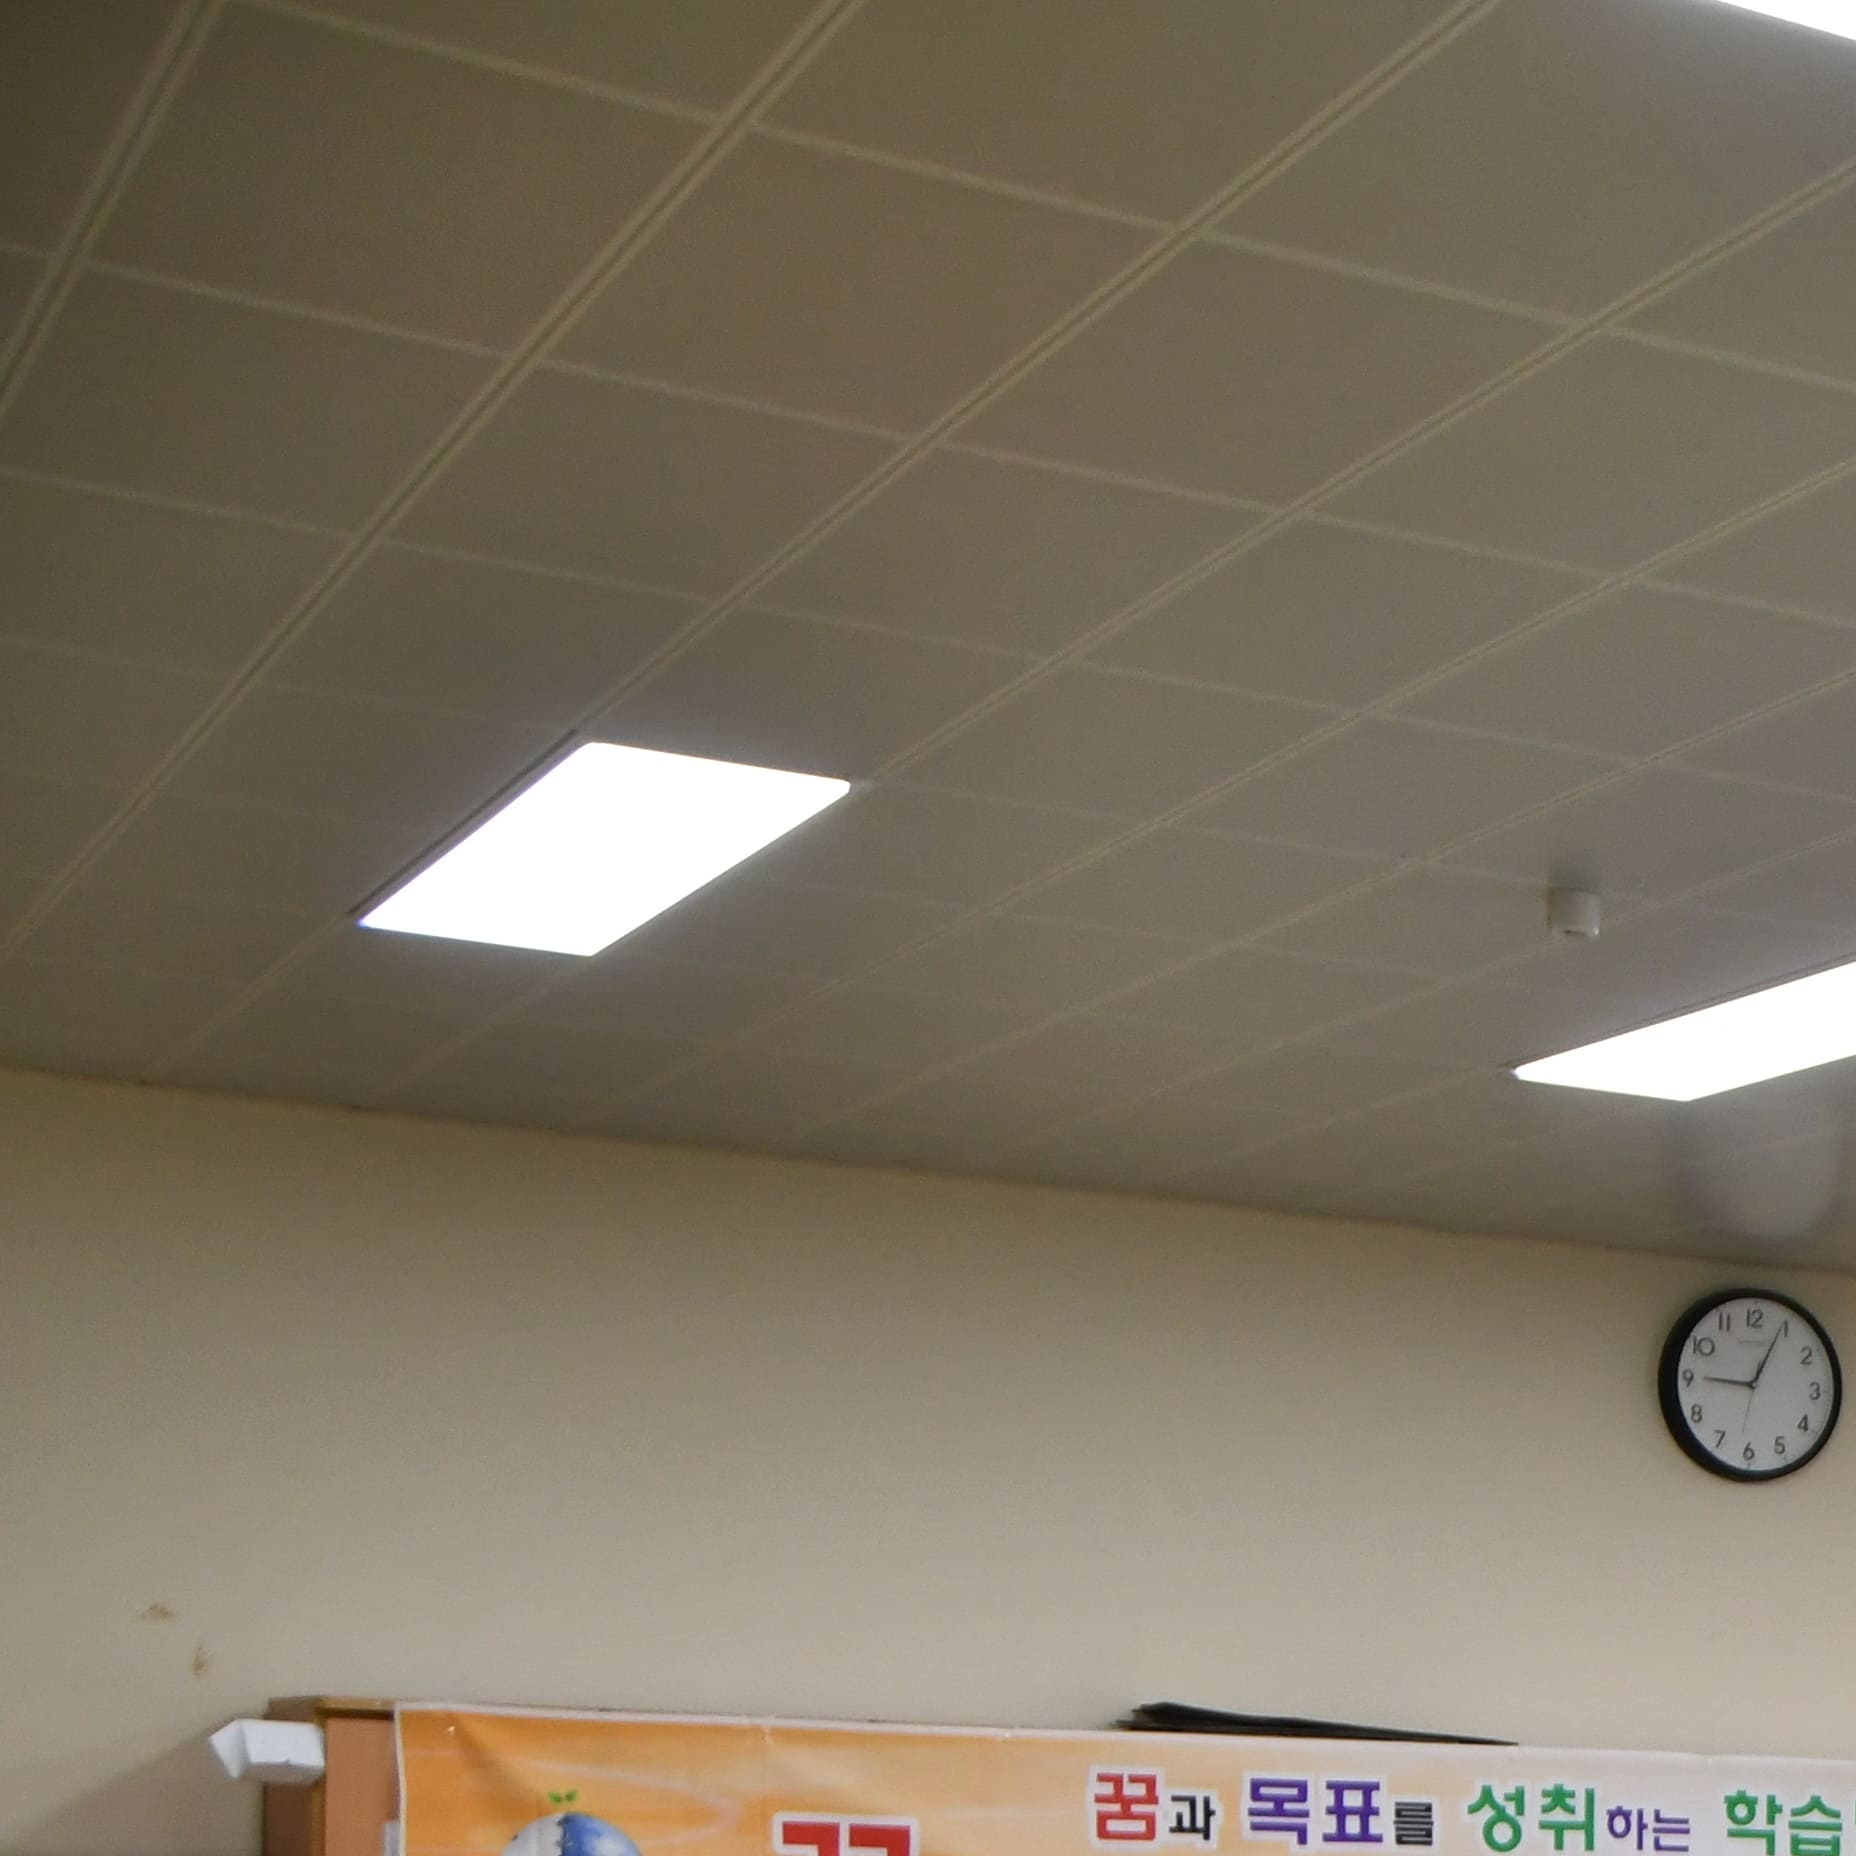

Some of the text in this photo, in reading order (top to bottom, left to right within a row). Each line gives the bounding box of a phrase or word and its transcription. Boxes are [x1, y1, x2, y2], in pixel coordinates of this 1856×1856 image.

[1718, 1312, 1731, 1332] 11
[1746, 1309, 1764, 1328] 12
[1692, 1335, 1715, 1356] 10
[1800, 1347, 1813, 1365] 2
[1682, 1368, 1694, 1387] 9
[1809, 1382, 1821, 1401] 3
[1690, 1404, 1703, 1423] 8
[1798, 1414, 1809, 1432] 4
[1715, 1430, 1726, 1448] 7
[1774, 1436, 1786, 1454] 5
[1743, 1442, 1755, 1461] 6
[1094, 1774, 1216, 1842] 꿈과
[1247, 1777, 1434, 1847] 목표를
[1468, 1783, 1690, 1853] 성취하는
